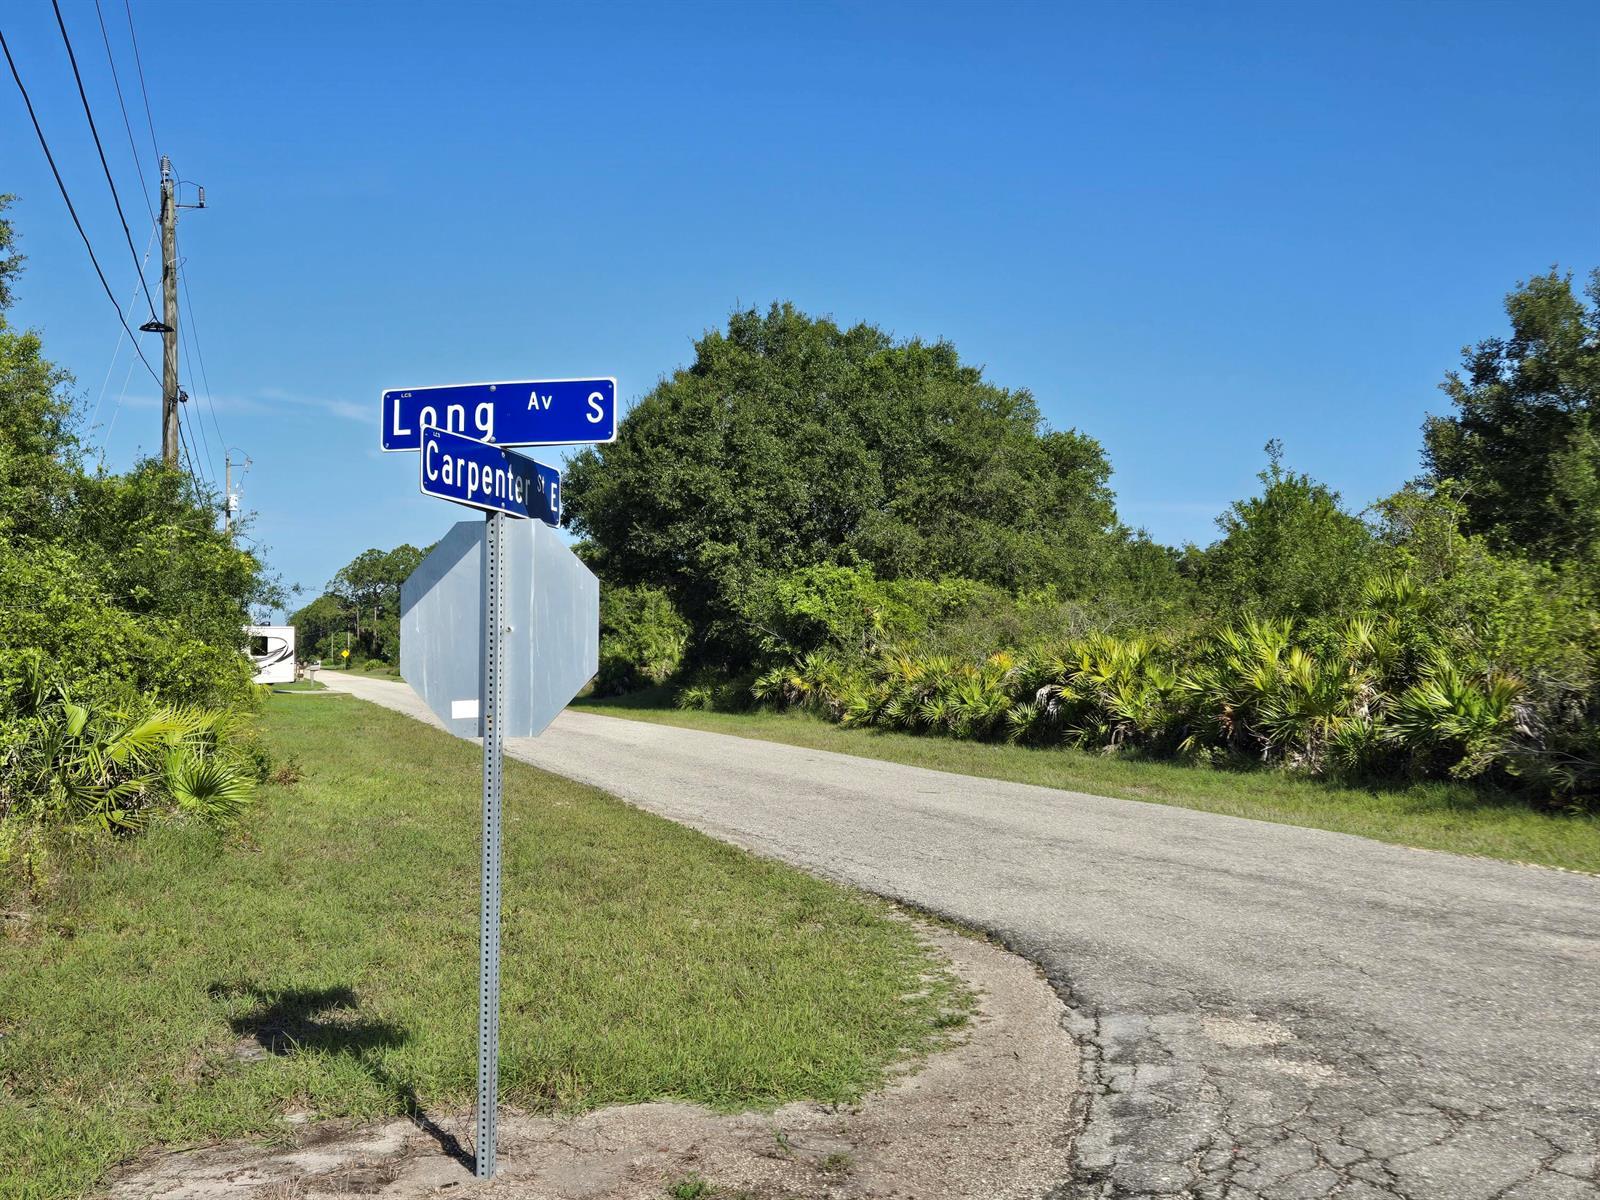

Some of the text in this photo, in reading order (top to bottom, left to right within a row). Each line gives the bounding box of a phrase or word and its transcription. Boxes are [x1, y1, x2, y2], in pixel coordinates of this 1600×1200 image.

[393, 391, 604, 442] Long Av S
[426, 439, 558, 511] Carpenter St E
